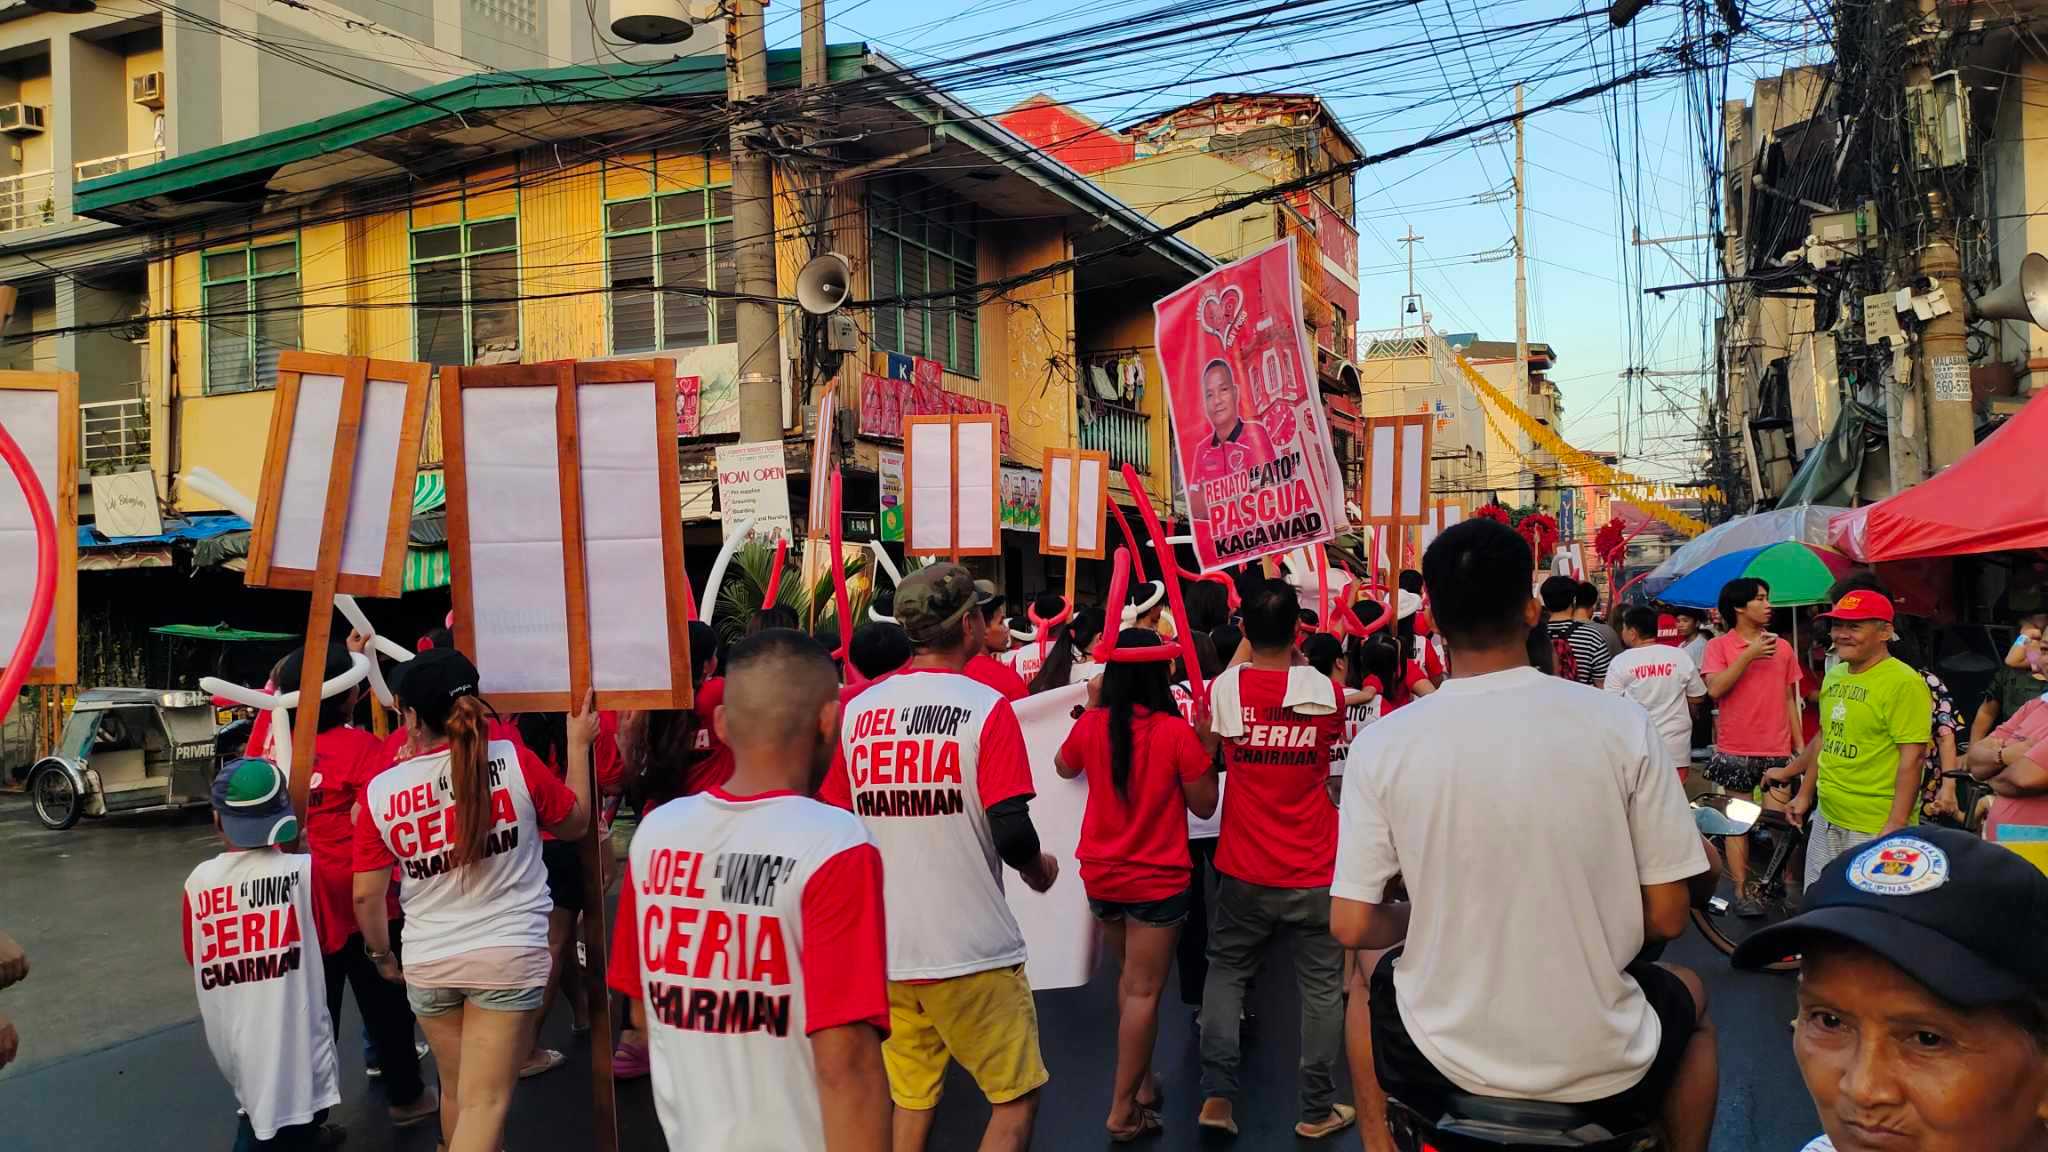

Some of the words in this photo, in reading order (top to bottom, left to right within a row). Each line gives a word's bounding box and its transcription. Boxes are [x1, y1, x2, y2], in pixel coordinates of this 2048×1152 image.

[720, 470, 749, 485] NOW
[754, 466, 784, 481] OPEN
[1205, 471, 1248, 503] RENATO
[1249, 452, 1300, 487] "ATO"
[1210, 478, 1314, 538] PASCUA
[1215, 512, 1322, 557] KAGAWAD
[1657, 628, 1678, 637] ERIA
[850, 709, 896, 743] JOEL
[900, 705, 971, 737] "JUNIOR"
[175, 743, 216, 760] PRIVATE
[851, 739, 962, 788] CERIA
[384, 782, 440, 822] JOEL
[390, 787, 518, 858] CEA
[405, 826, 519, 880] CHAAN
[643, 848, 706, 899] JOEL
[201, 903, 302, 964] CERIA
[644, 904, 791, 986] CERIA
